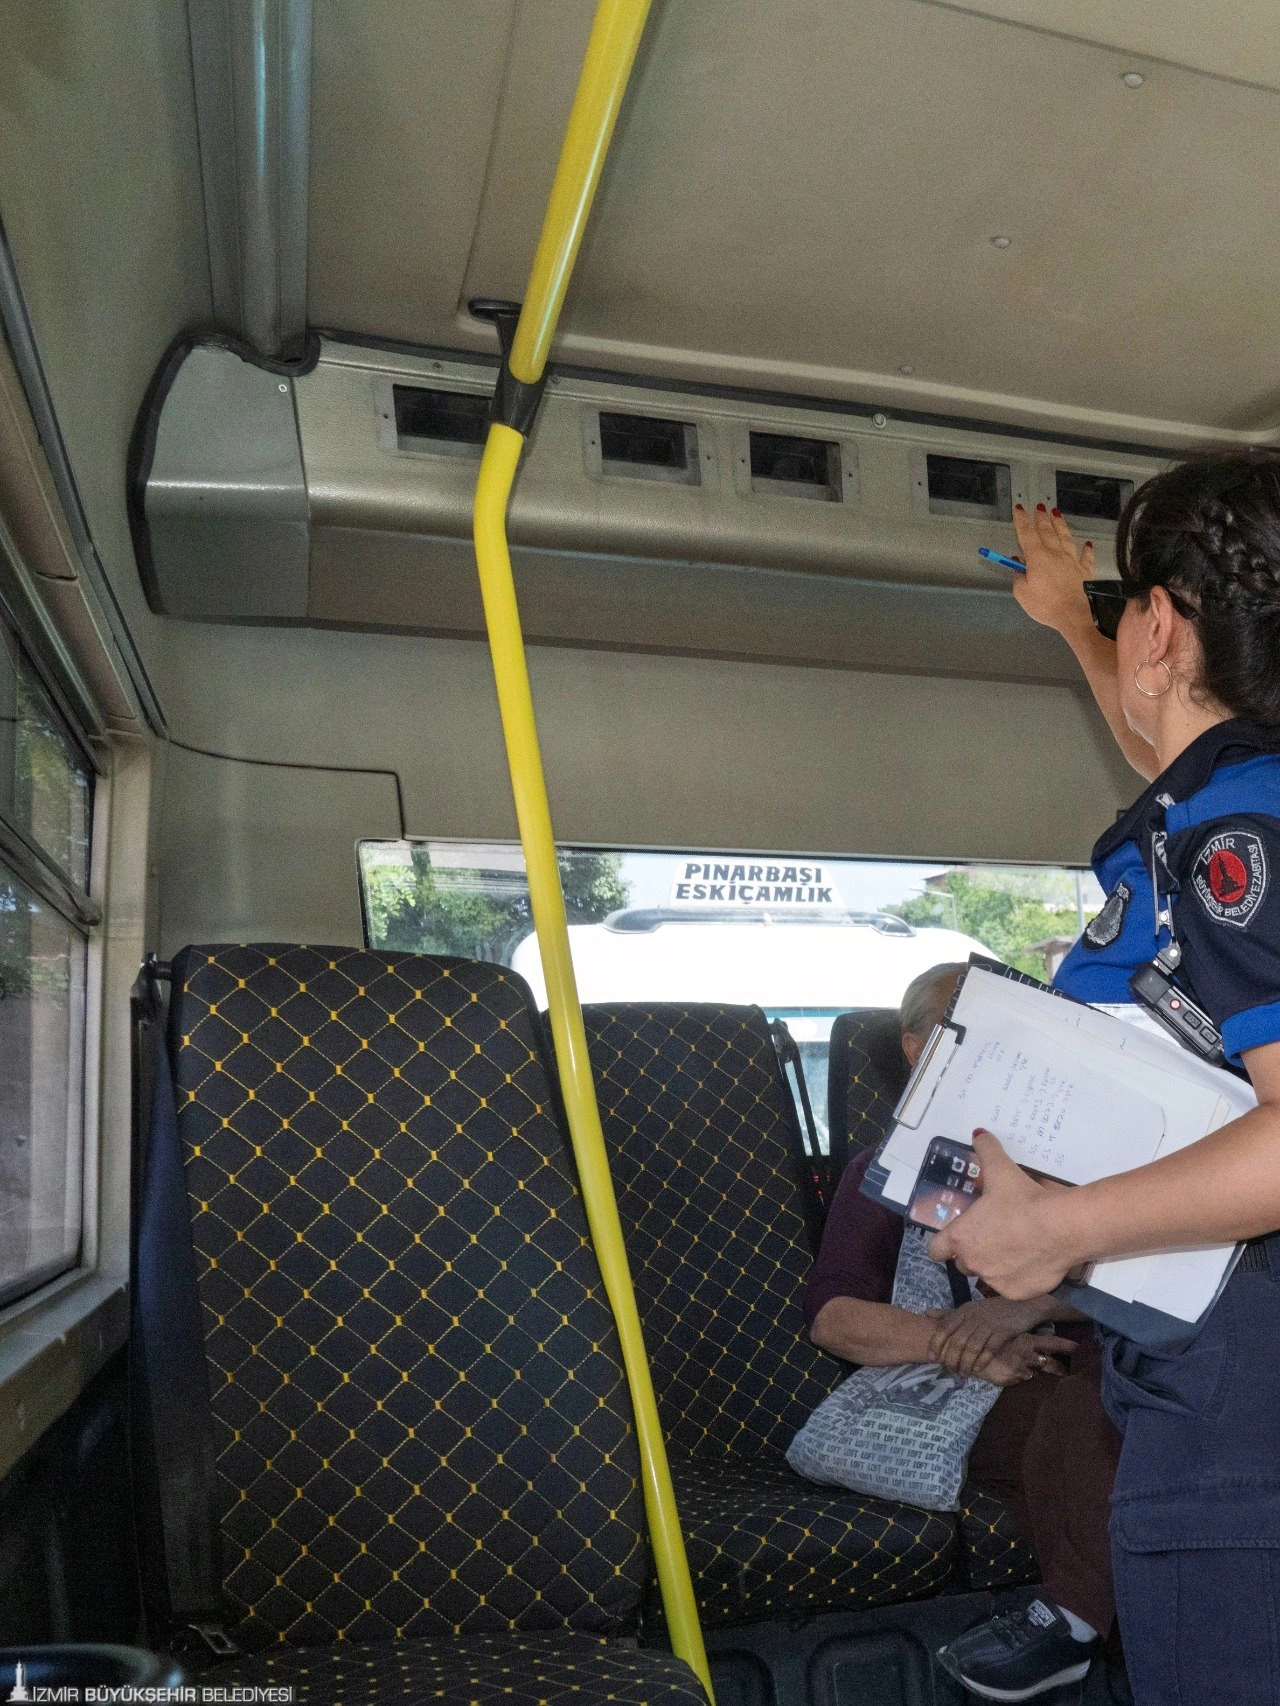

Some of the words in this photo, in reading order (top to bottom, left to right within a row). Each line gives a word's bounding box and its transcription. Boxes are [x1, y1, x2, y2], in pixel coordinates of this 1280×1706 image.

[1200, 837, 1236, 865] İZMİR
[684, 863, 822, 885] PINARBAŞI
[675, 880, 833, 904] ESKİÇAMLIK
